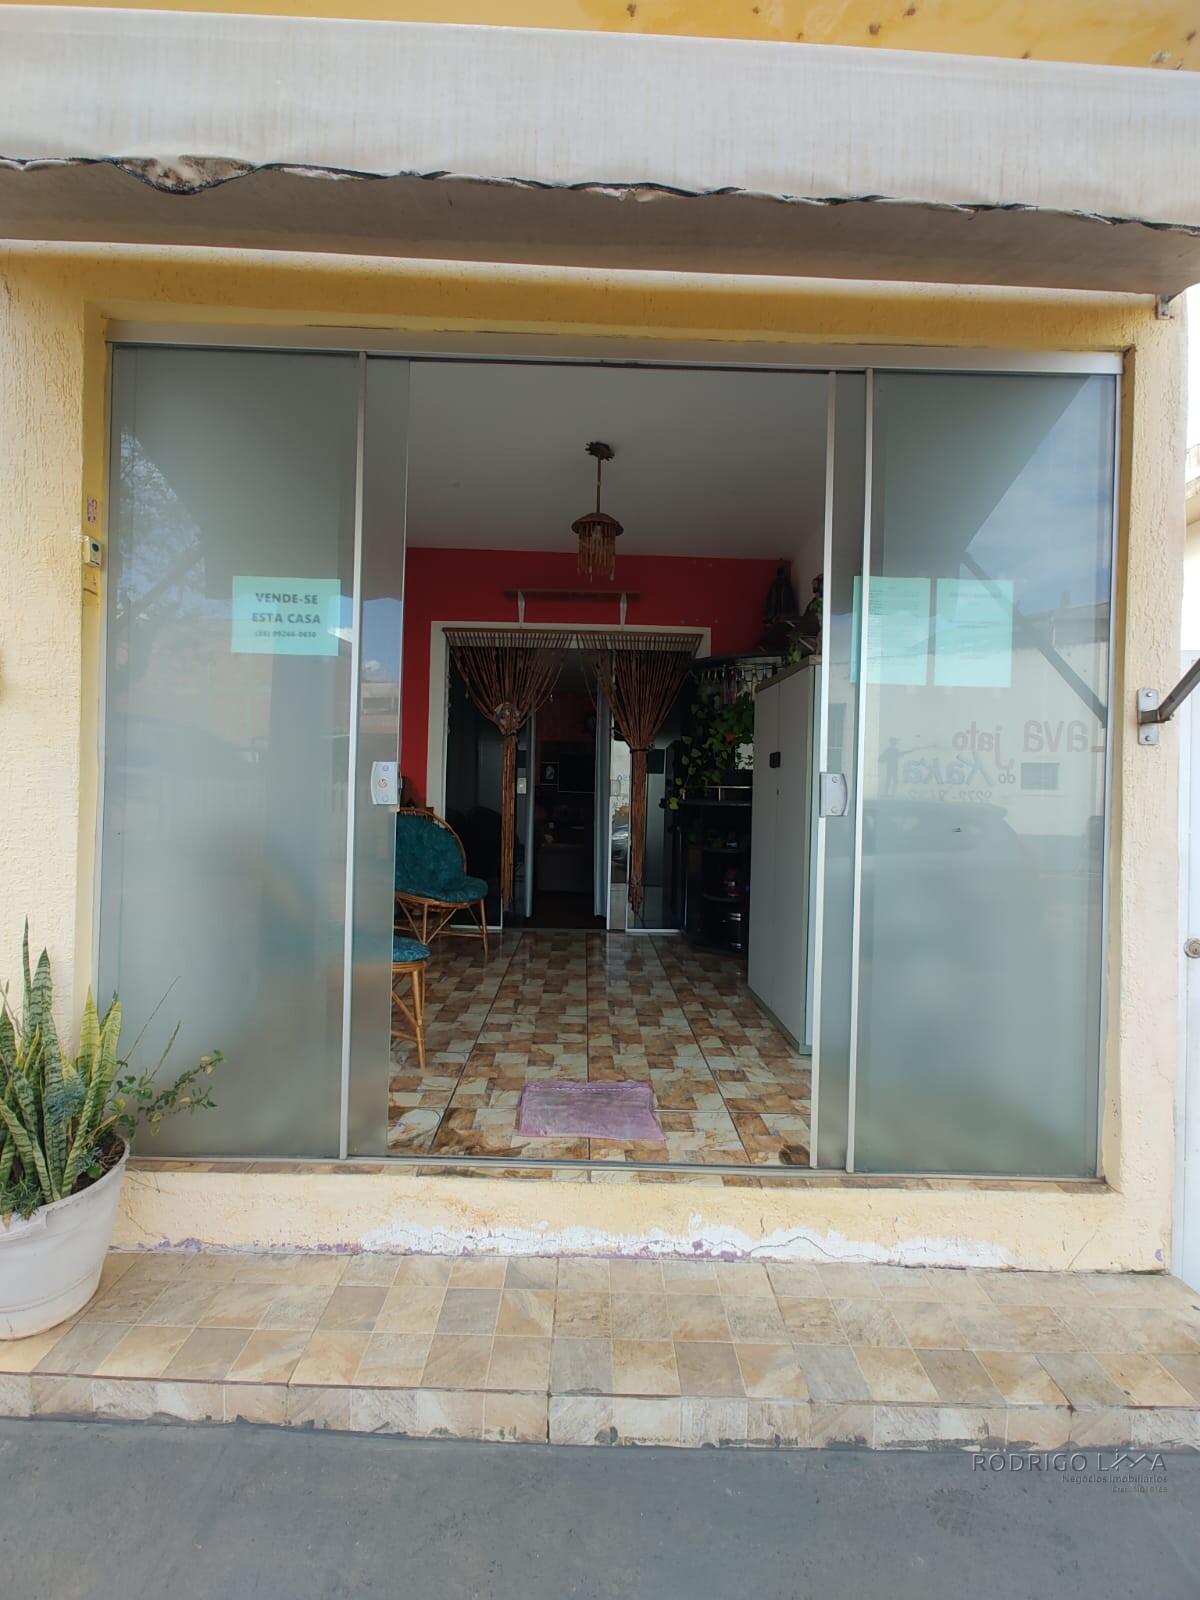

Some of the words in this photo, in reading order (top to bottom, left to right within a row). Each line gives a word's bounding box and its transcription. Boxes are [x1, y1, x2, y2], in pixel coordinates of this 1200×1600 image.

[255, 592, 318, 604] VENDE-SE
[252, 612, 283, 624] ESTA
[287, 613, 321, 625] CASA
